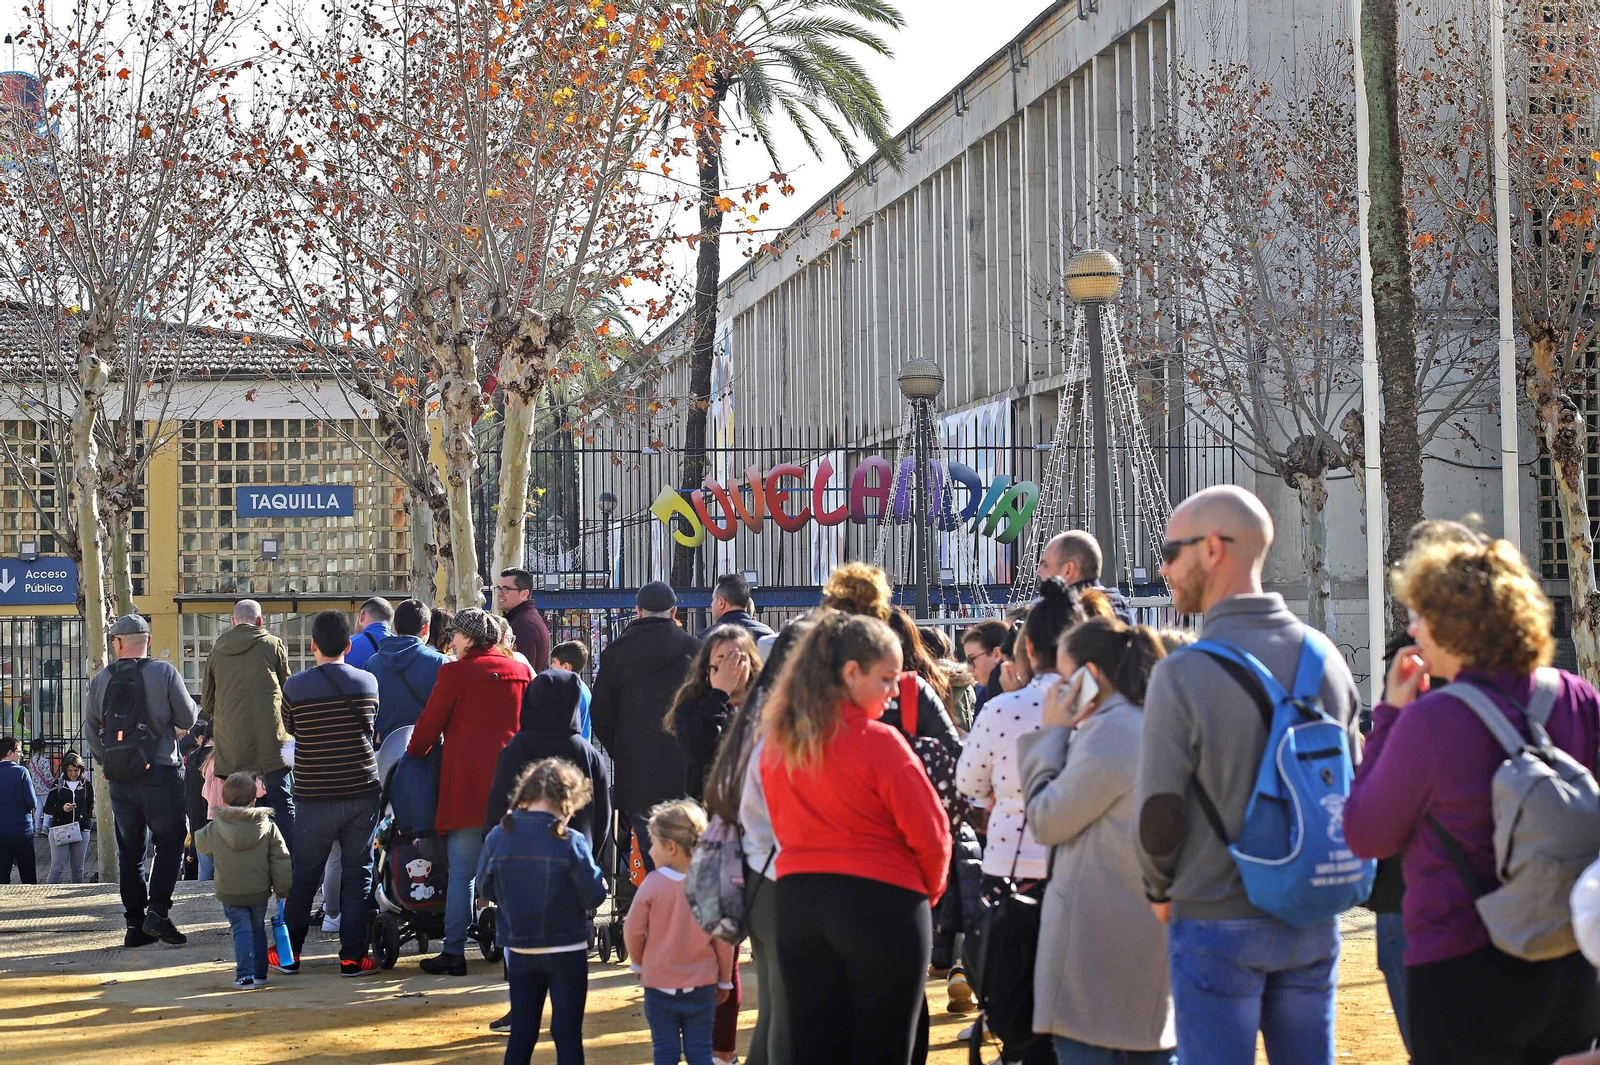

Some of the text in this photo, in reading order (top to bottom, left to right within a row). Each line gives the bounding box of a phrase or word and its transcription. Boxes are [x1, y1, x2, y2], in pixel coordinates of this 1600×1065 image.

[249, 493, 340, 510] TAQUILLA
[650, 455, 1040, 548] JUVELANDIA
[25, 569, 68, 579] Acceso
[25, 582, 64, 593] Público
[544, 593, 624, 604] PROVINCIAL
